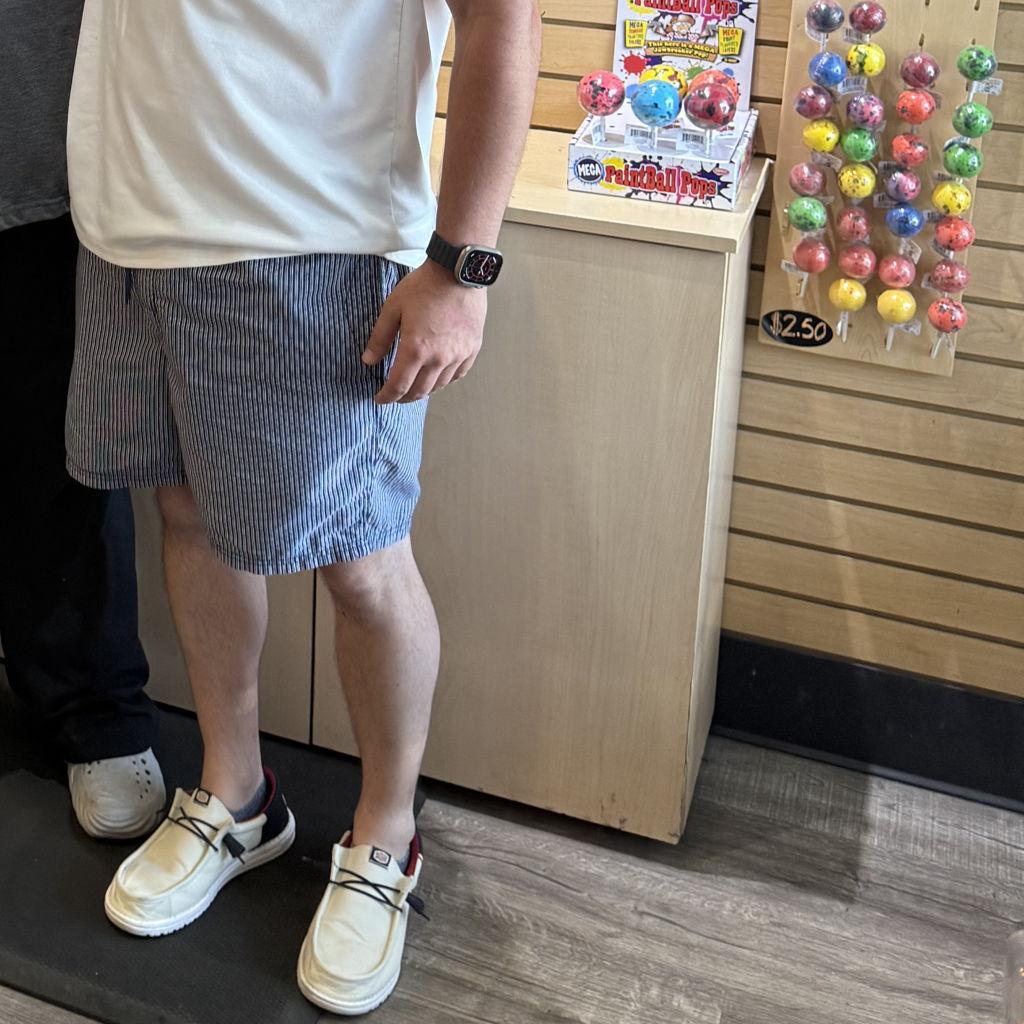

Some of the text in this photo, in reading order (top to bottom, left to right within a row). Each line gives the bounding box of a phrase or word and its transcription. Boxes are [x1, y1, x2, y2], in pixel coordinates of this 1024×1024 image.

[722, 29, 739, 37] MEGA
[577, 164, 602, 177] MEGA
[603, 164, 717, 199] PaintBall Pops
[769, 311, 827, 342] $2.50
